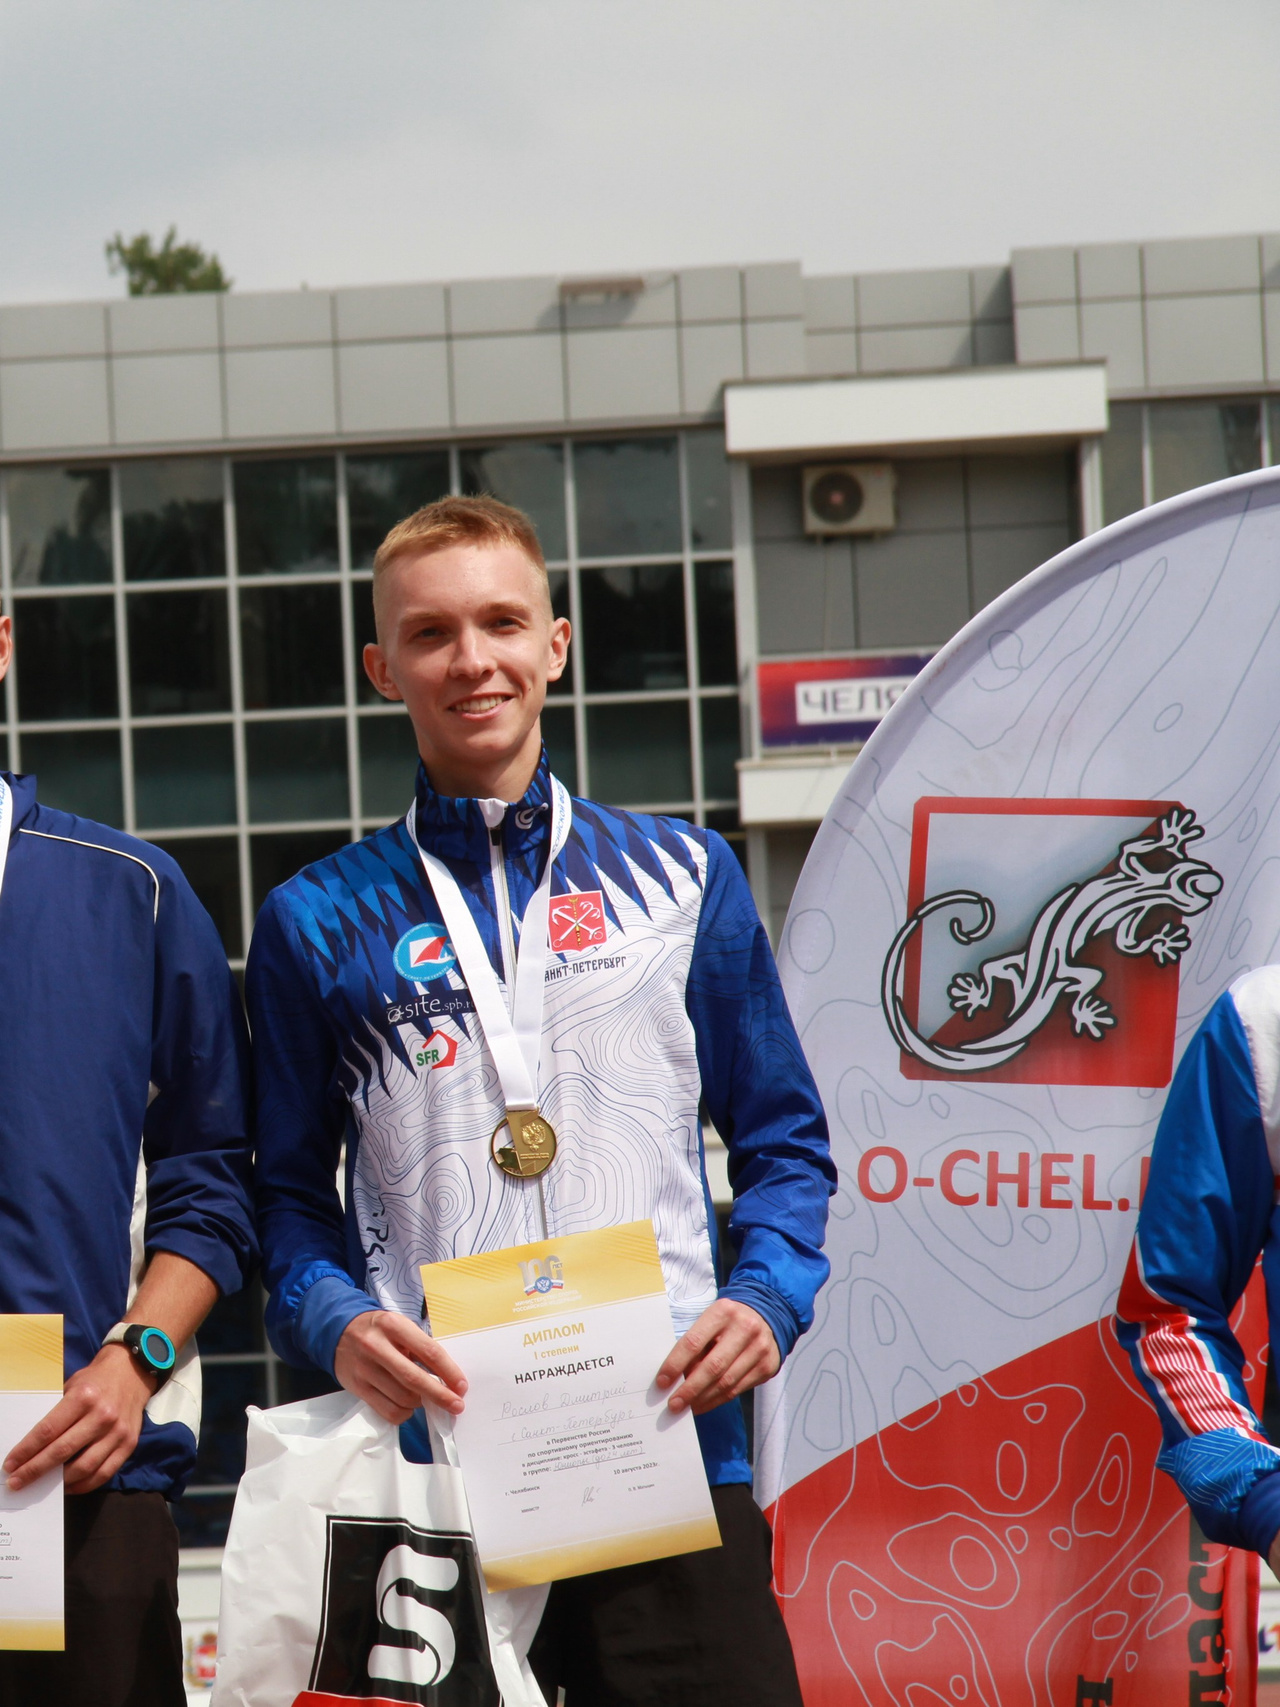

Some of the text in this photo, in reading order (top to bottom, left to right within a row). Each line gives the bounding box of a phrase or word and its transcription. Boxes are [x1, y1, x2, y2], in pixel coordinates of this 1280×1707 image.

[416, 1049, 440, 1067] SFR
[523, 1322, 585, 1347] ДИПЛОМ
[541, 1345, 579, 1359] степени
[514, 1356, 614, 1384] НАГРАЖДАЕТСЯ
[537, 1444, 578, 1457] спортивному
[579, 1433, 634, 1448] ориентированию
[551, 1433, 588, 1446] Первенстве
[588, 1428, 611, 1437] России
